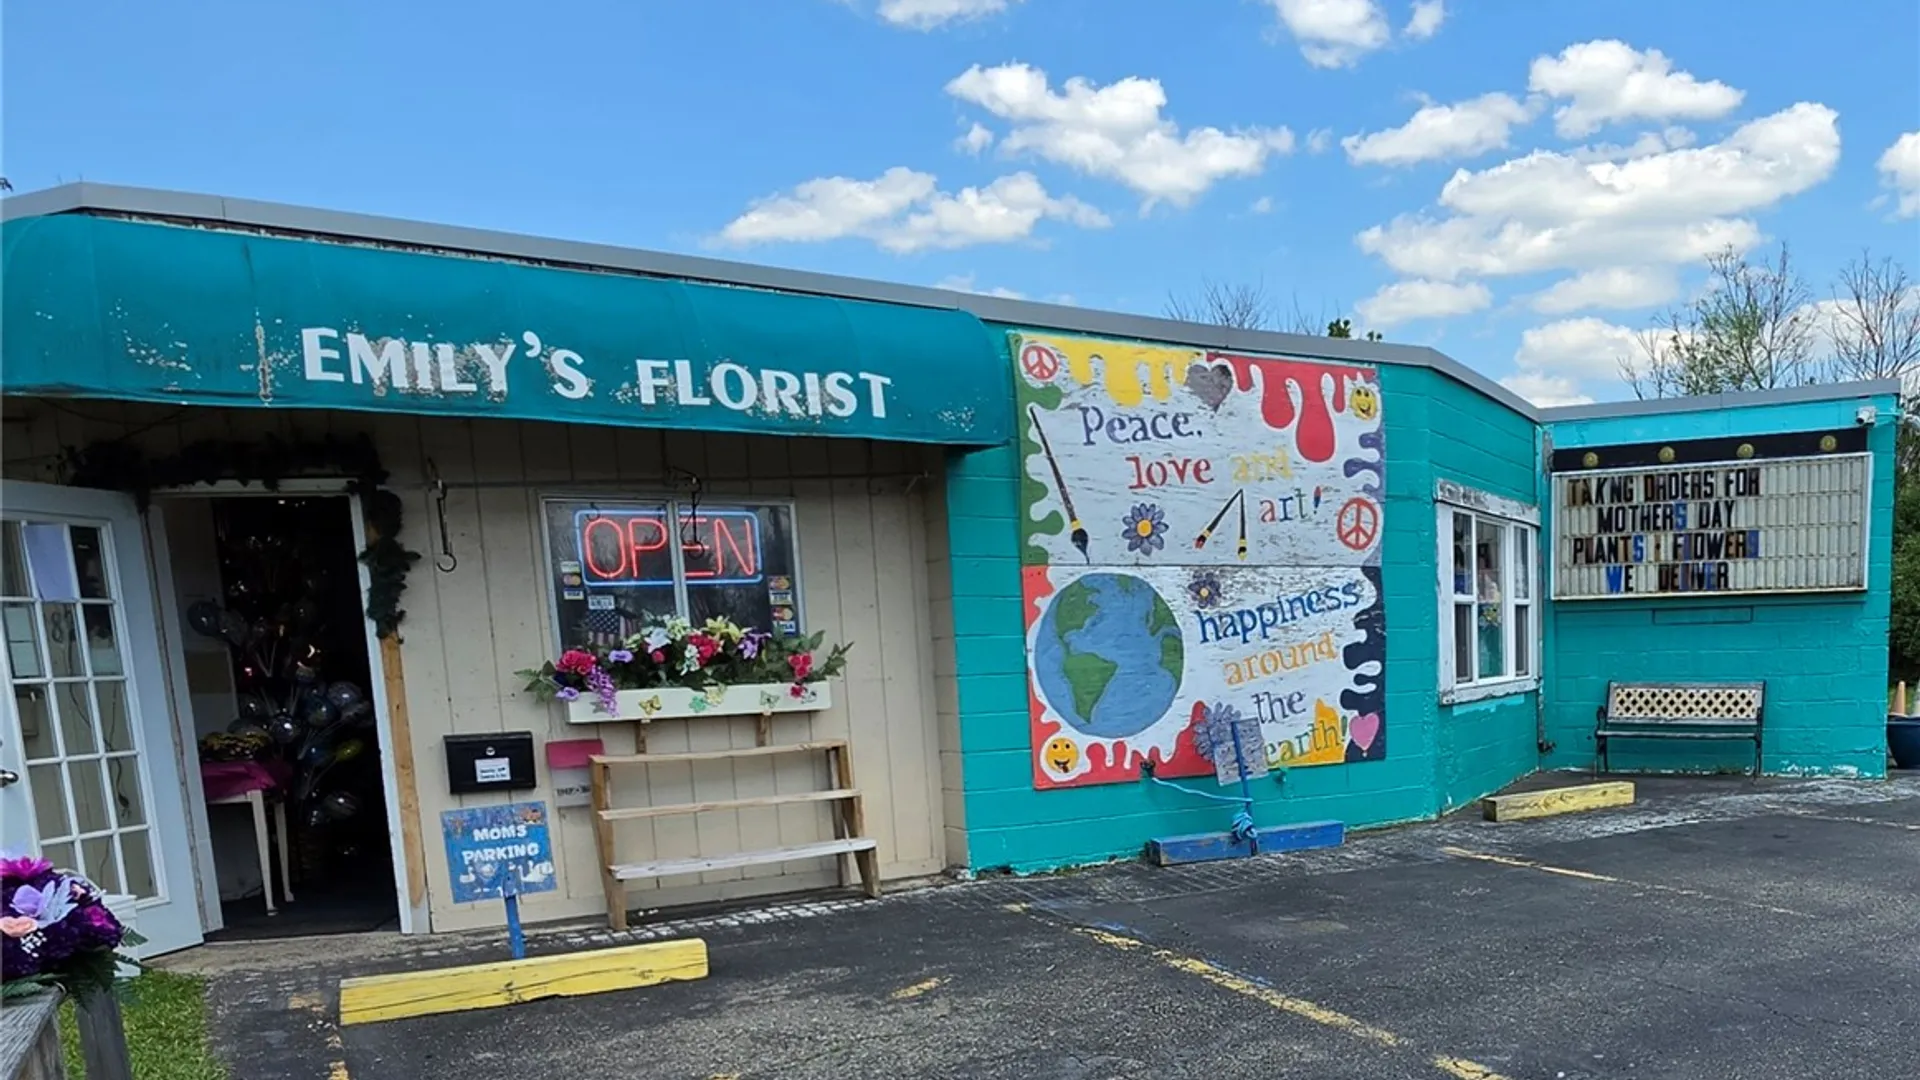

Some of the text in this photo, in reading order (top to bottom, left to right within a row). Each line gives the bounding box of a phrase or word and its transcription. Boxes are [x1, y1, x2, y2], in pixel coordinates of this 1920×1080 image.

[302, 328, 891, 418] EMILY'S FLORIST
[1125, 449, 1294, 489] love and
[1725, 467, 1760, 497] FOR
[1259, 485, 1322, 523] art!
[1598, 501, 1735, 533] MOTHERS DAY
[583, 517, 755, 578] OPEN
[1573, 535, 1644, 565] PLANTS
[1606, 564, 1634, 594] WE
[1194, 582, 1360, 644] happiness
[1224, 629, 1338, 685] around
[1252, 691, 1306, 724] the
[1263, 715, 1348, 766] earth!
[472, 824, 528, 842] MOMS
[461, 842, 540, 865] PARKING
